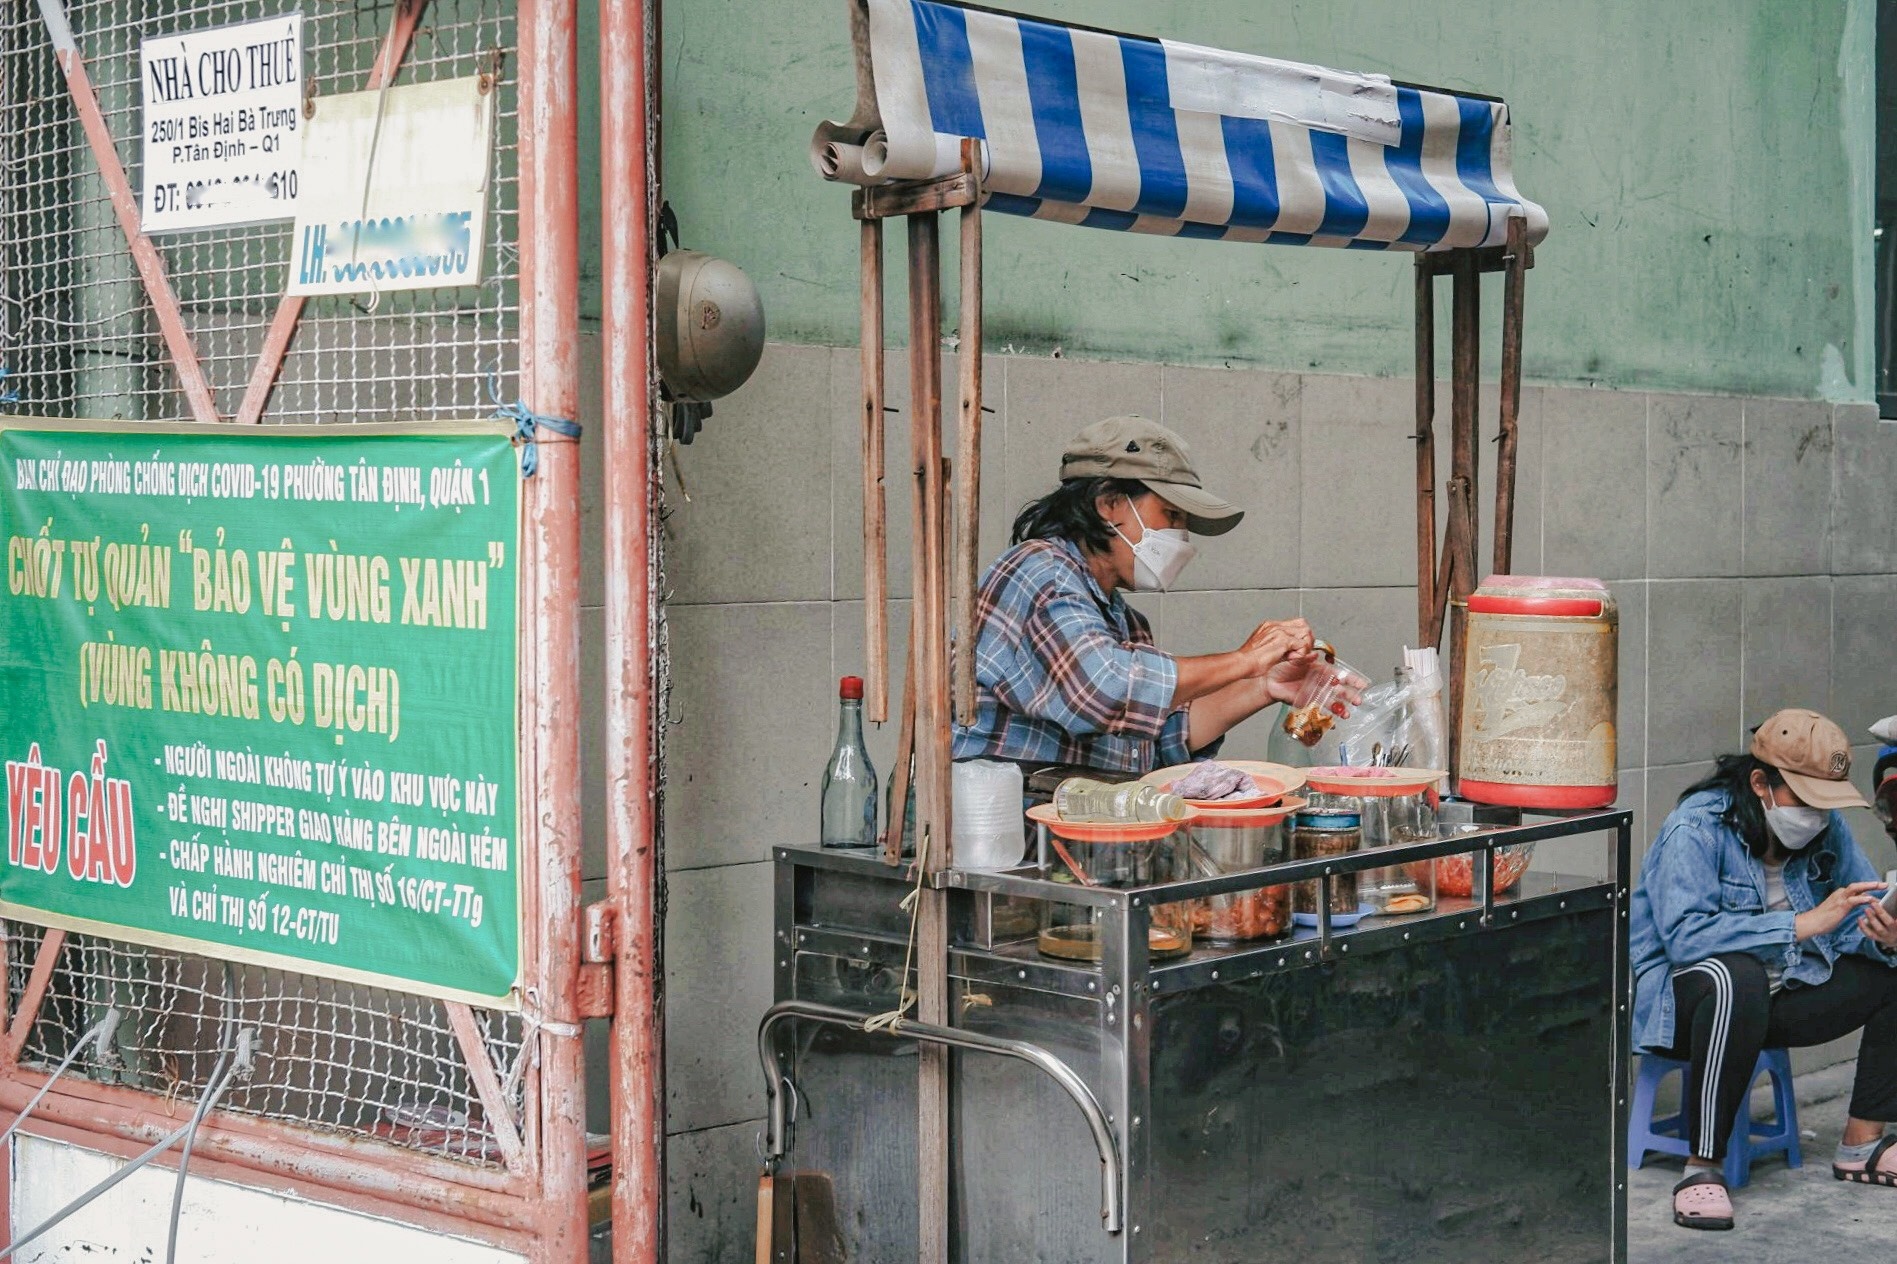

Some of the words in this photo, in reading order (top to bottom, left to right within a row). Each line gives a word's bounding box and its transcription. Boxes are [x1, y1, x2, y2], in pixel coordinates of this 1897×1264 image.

[148, 41, 194, 104] NHÀ
[198, 47, 242, 97] CHO
[246, 22, 297, 90] THUÊ
[151, 117, 184, 144] 250/1
[189, 115, 209, 139] Bis
[213, 111, 235, 136] Hai
[238, 107, 255, 132] Bà
[259, 105, 297, 131] Trưng
[172, 143, 210, 164] P.Tân
[213, 138, 246, 162] Định
[262, 133, 281, 154] Q1
[154, 182, 181, 213] ĐT:
[16, 458, 38, 491] BAN
[39, 449, 62, 492] CHỈ
[61, 459, 88, 501] ĐẠO
[90, 452, 131, 494] PHÒNG
[134, 449, 175, 496] CHỐNG
[178, 462, 209, 504] DỊCH
[212, 462, 280, 500] COVID-19
[284, 456, 345, 502] PHƯỜNG
[349, 456, 379, 503] TÂN
[382, 466, 426, 512] ĐỊNH,
[430, 458, 476, 514] QUẬN
[478, 467, 490, 506] 1
[8, 516, 66, 599] CHỐT
[71, 535, 101, 616] TỰ
[104, 522, 172, 612] QUẢN
[257, 537, 296, 633] VỆ
[304, 539, 391, 624] VÙNG
[80, 630, 152, 709] (VÙNG
[159, 638, 260, 720] KHÔNG
[266, 645, 306, 726] CÓ
[312, 662, 400, 745] DỊCH)
[5, 741, 63, 875] YÊU
[67, 738, 137, 889] CẦU
[215, 745, 262, 785] NGOÀI
[264, 751, 313, 793] KHÔNG
[315, 760, 336, 803] TỰ
[338, 758, 348, 797] Ý
[351, 760, 385, 802] VÀO
[390, 771, 425, 807] KHU
[428, 773, 461, 818] VỰC
[465, 773, 499, 816] NÀY
[190, 794, 228, 836] NGHỊ
[231, 799, 296, 838] SHIPPER
[298, 808, 332, 845] GIAO
[332, 808, 374, 852] HÀNG
[377, 814, 412, 857] BÊN
[416, 823, 467, 865] NGOÀI
[470, 826, 508, 871] HẺM
[169, 881, 189, 918] VÀ
[192, 883, 217, 923] CHỈ
[221, 894, 245, 936] THỊ
[248, 890, 270, 933] SỐ
[272, 903, 340, 946] 12-CT/TU
[213, 839, 254, 881] HÀNH
[258, 850, 317, 891] NGHIÊM
[321, 855, 347, 896] CHỈ
[349, 866, 376, 908] THỊ
[375, 862, 397, 907] SỐ
[397, 876, 484, 929] 16/CT-TTg
